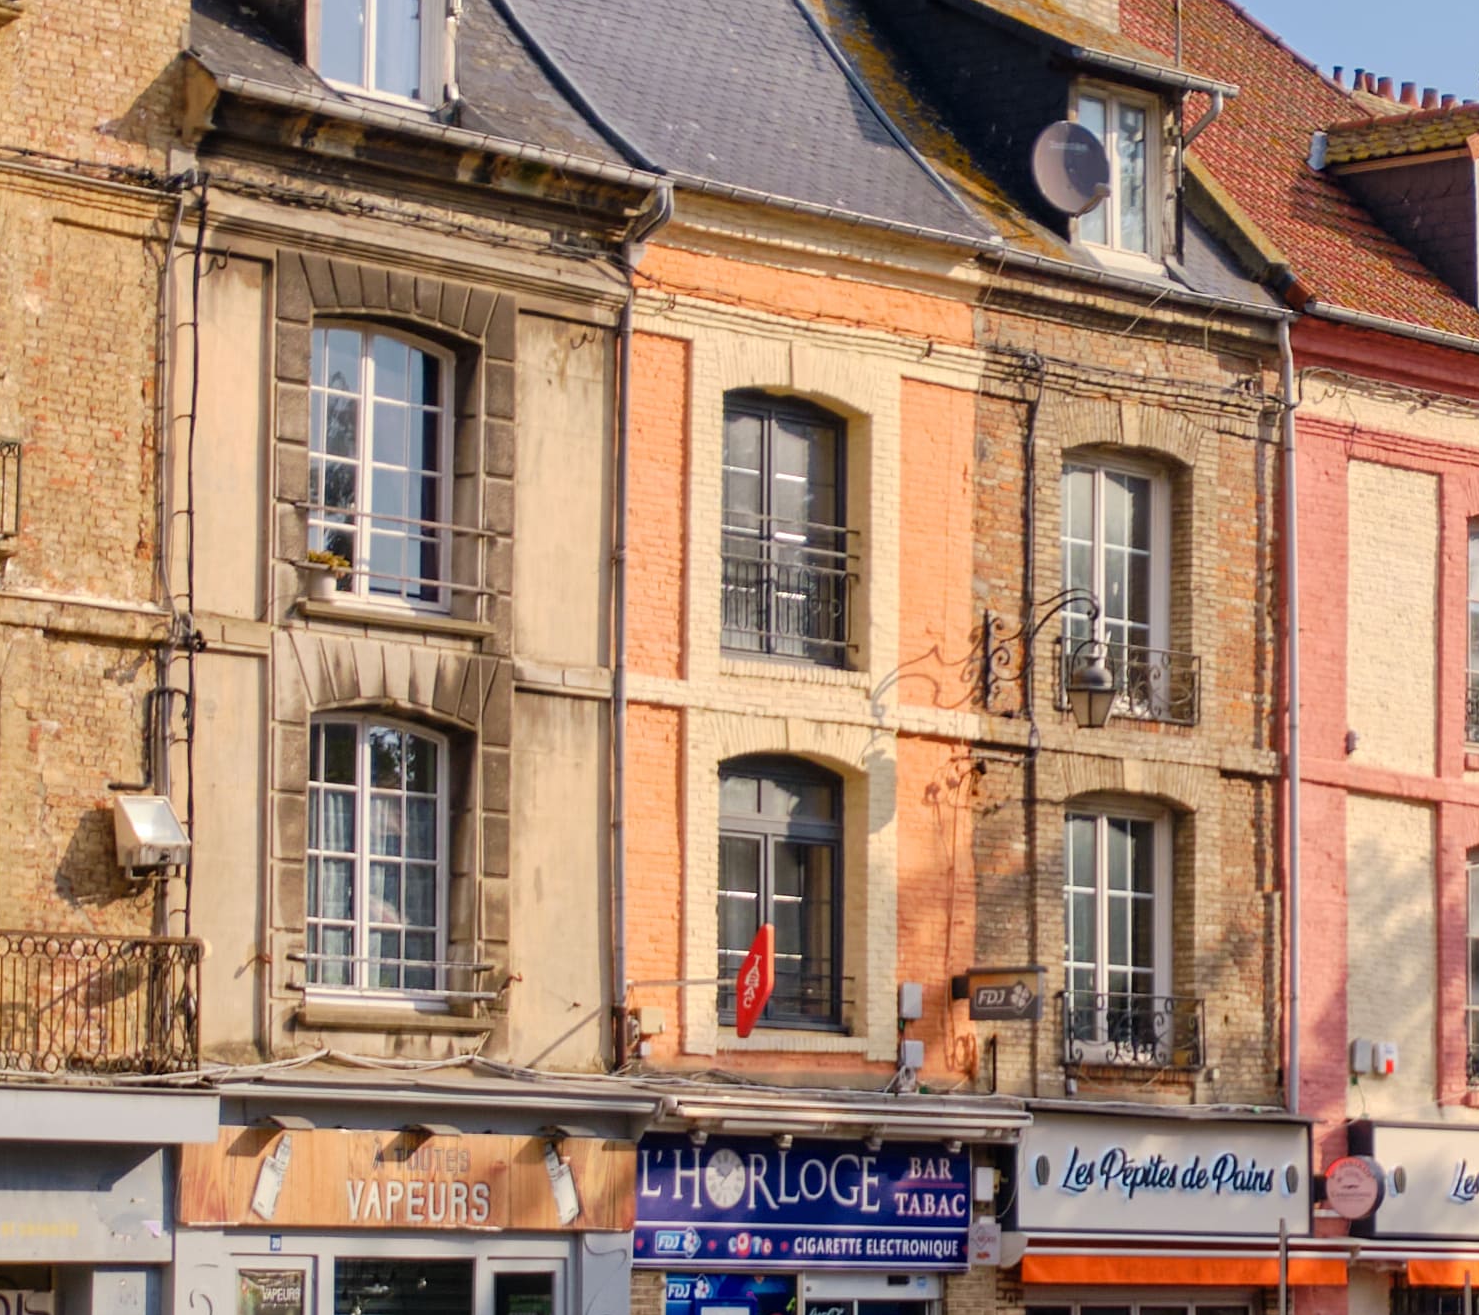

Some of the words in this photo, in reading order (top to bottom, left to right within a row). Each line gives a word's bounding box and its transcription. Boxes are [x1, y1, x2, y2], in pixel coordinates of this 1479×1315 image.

[394, 1148, 470, 1173] TOUTES
[909, 1157, 953, 1180] BAR
[1062, 1146, 1095, 1193] Les
[1099, 1147, 1177, 1199] Pépites
[1181, 1155, 1209, 1190] de
[1211, 1152, 1274, 1195] Pains
[640, 1148, 881, 1212] L'HORLOGE
[346, 1180, 491, 1222] VAPEURS
[894, 1193, 966, 1217] TABAC
[657, 1234, 681, 1249] FDJ
[794, 1236, 862, 1256] CIGARETTE
[866, 1238, 959, 1259] ELECTRONIQUE
[667, 1283, 691, 1299] FDJ
